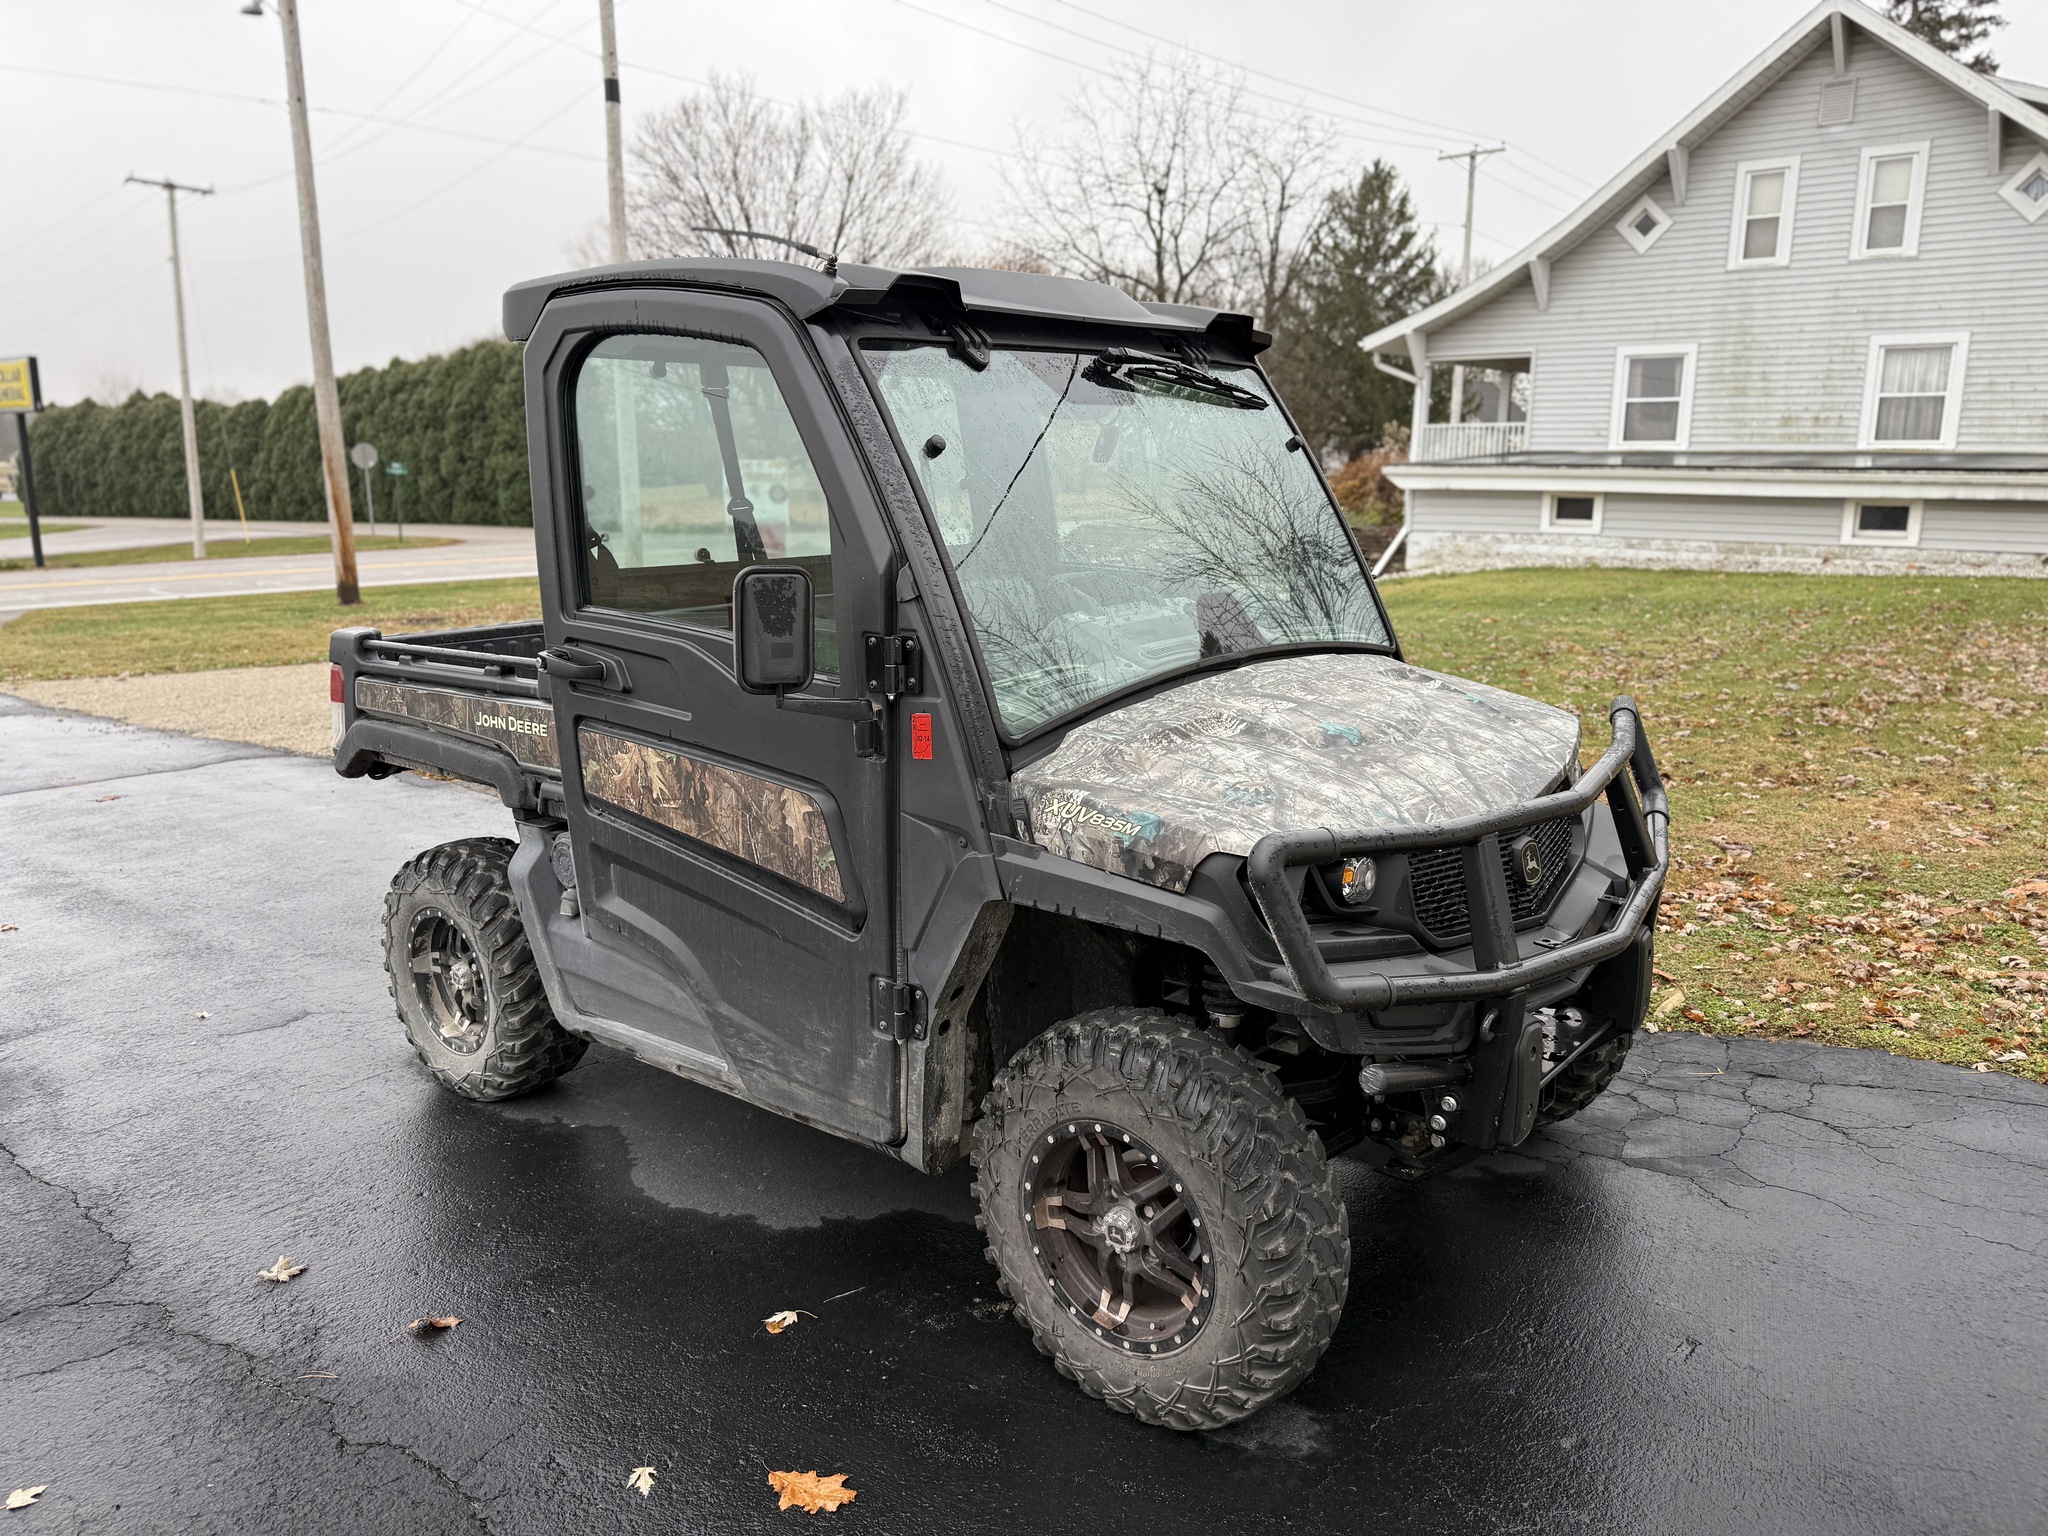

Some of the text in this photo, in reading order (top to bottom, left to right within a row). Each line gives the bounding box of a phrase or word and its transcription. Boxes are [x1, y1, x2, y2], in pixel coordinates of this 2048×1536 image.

[476, 711, 548, 737] JOHN DEERE
[1043, 799, 1142, 836] XUV835M
